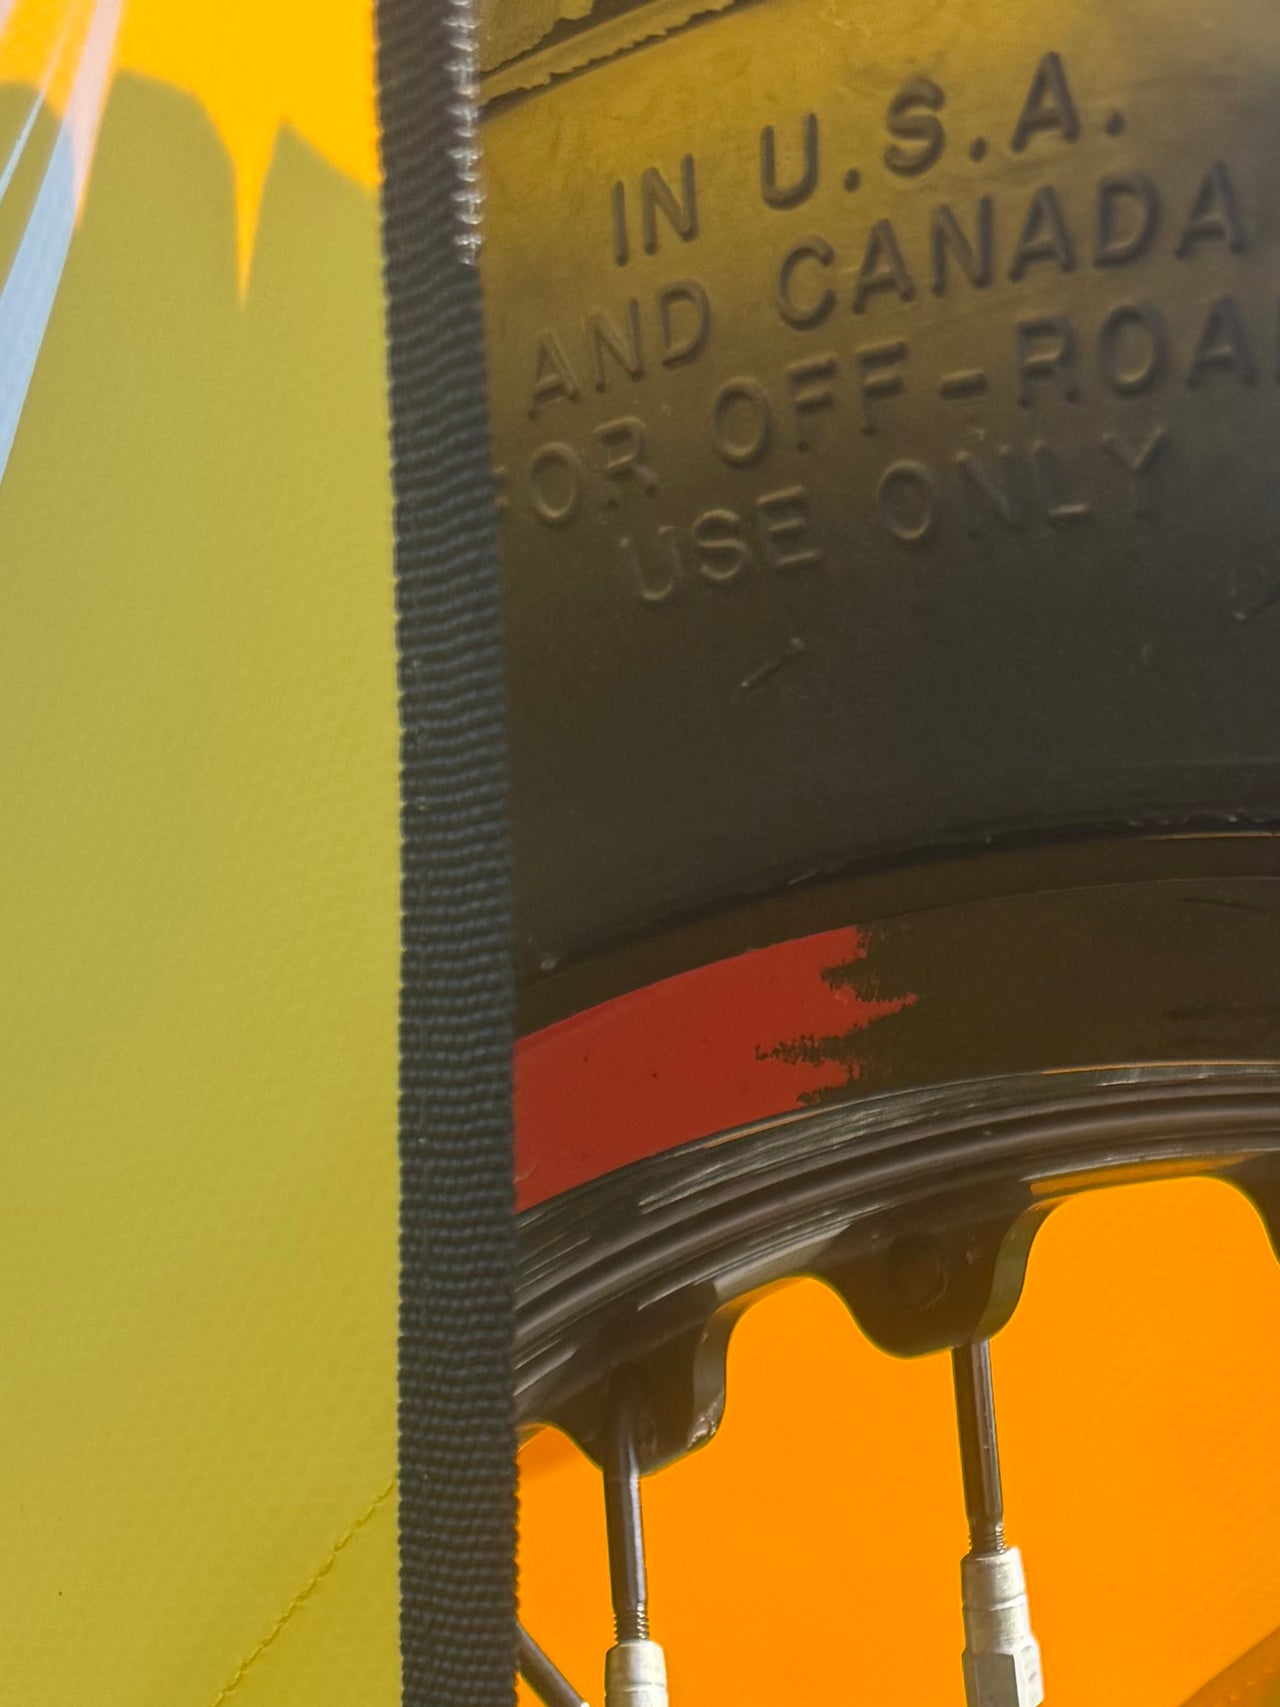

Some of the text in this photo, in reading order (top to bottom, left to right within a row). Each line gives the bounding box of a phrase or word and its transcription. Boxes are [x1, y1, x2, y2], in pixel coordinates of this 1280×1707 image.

[609, 51, 1125, 266] IN U.S.A.
[526, 161, 1250, 420] AND CANADA
[496, 416, 660, 526] OR
[623, 426, 1166, 603] USE ONLY
